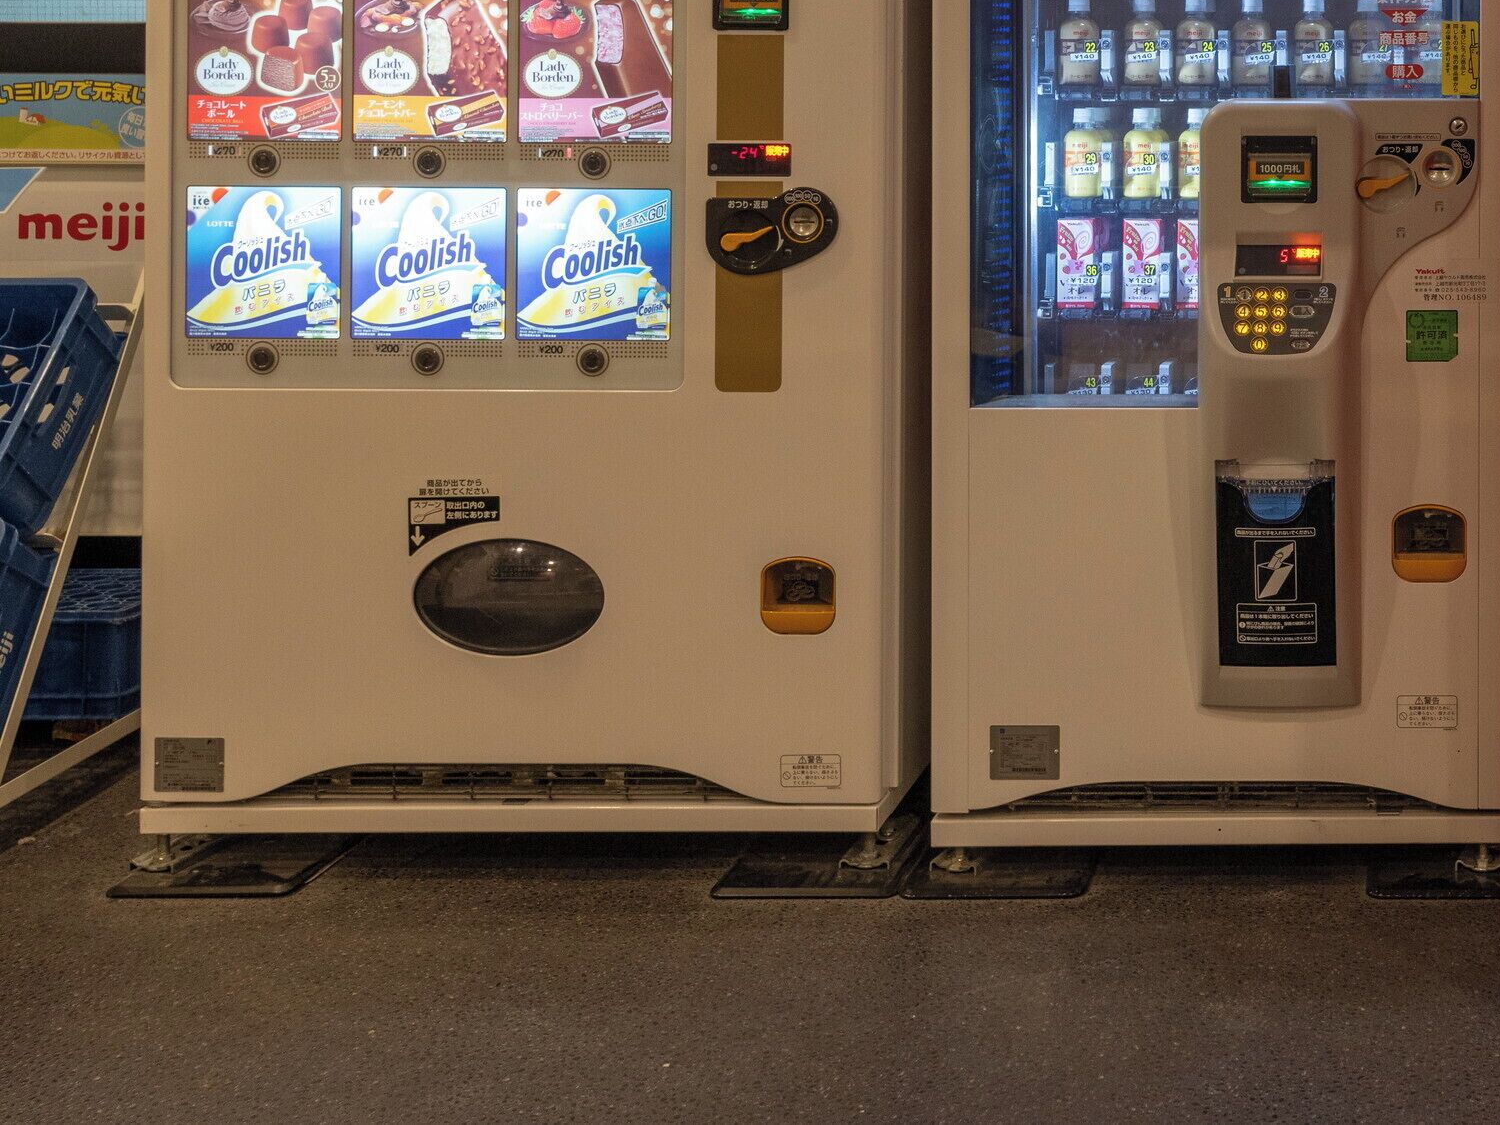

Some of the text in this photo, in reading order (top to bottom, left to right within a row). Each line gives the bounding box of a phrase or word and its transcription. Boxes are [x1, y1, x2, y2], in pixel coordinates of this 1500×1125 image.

[1392, 12, 1416, 23] お金
[1380, 33, 1429, 44] 商品番号
[1085, 43, 1096, 52] 22
[1144, 42, 1154, 51] 23
[1203, 42, 1213, 51] 24
[1262, 44, 1271, 52] 25
[1319, 43, 1329, 51] 26
[211, 59, 238, 71] Lady
[377, 58, 403, 71] Lady
[540, 61, 567, 74] Lady
[204, 70, 245, 80] Borden
[369, 69, 409, 80] Borden
[1393, 66, 1418, 78] 購入
[533, 72, 574, 82] Borden
[197, 100, 246, 109] チョコレート
[368, 100, 406, 108] アーモンド
[540, 103, 563, 111] チョコ
[359, 109, 416, 118] チョコレートバー
[521, 111, 583, 120] ストロベリーバー
[1086, 154, 1096, 163] 29
[1144, 154, 1154, 164] 30
[1260, 164, 1300, 173] 1000円札
[18, 202, 145, 251] meiji
[213, 232, 306, 287] Coolish
[377, 233, 471, 288] Coolish
[545, 236, 638, 288] Coolish
[1086, 266, 1097, 275] 36
[1145, 265, 1155, 274] 37
[242, 279, 286, 301] バニラ
[407, 280, 463, 303] バニラ
[573, 282, 617, 303] バニラ
[209, 343, 234, 351] ¥200
[375, 343, 399, 354] ¥200
[539, 346, 563, 354] ¥200
[1086, 378, 1095, 387] 43
[1144, 378, 1153, 387] 44
[427, 479, 482, 487] 商品が出てから
[446, 511, 497, 519] 左側にあります
